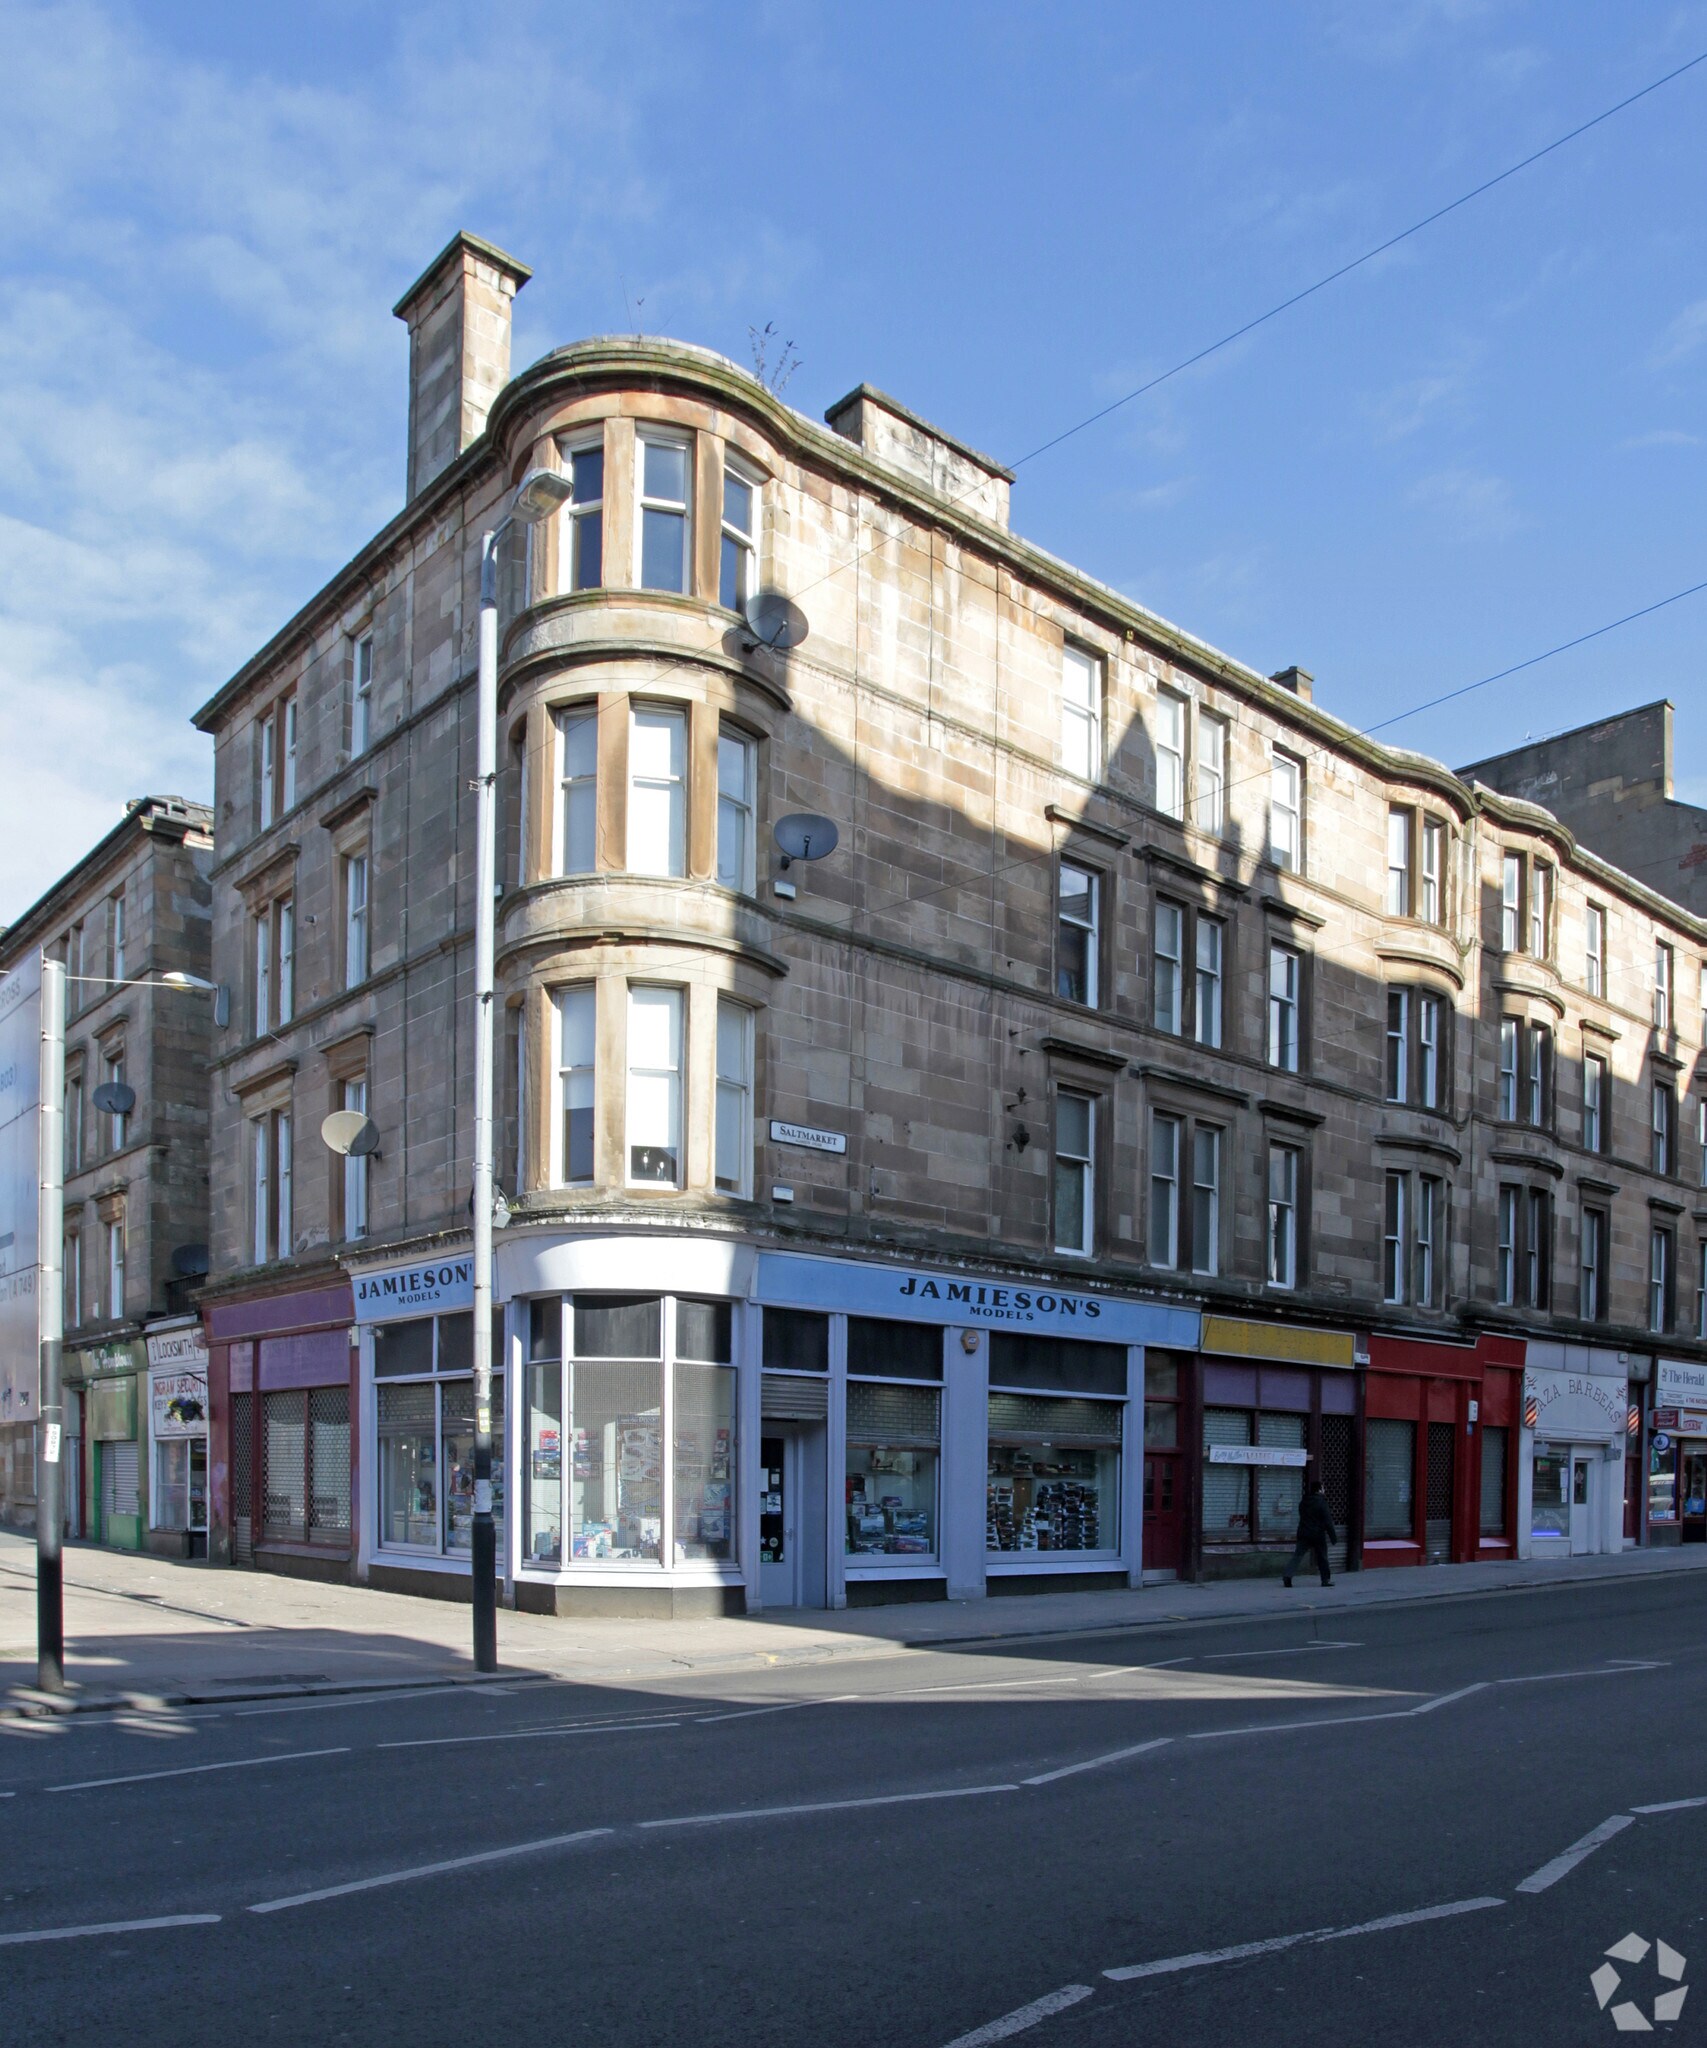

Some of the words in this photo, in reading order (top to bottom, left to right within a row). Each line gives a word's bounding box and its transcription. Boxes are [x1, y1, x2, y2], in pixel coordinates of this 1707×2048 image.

[0, 977, 20, 1008] ROSS
[780, 1125, 837, 1146] SALTMARKET
[359, 1263, 473, 1300] JAMIESON'
[398, 1290, 441, 1305] MODELS
[899, 1277, 1101, 1318] JAMIESON'S
[969, 1306, 1034, 1321] MODELS
[159, 1338, 193, 1359] LOCKSMITH
[1669, 1369, 1683, 1384] The
[1683, 1371, 1705, 1387] Herald
[1536, 1384, 1561, 1417] AZA
[1568, 1379, 1622, 1423] BARBERS
